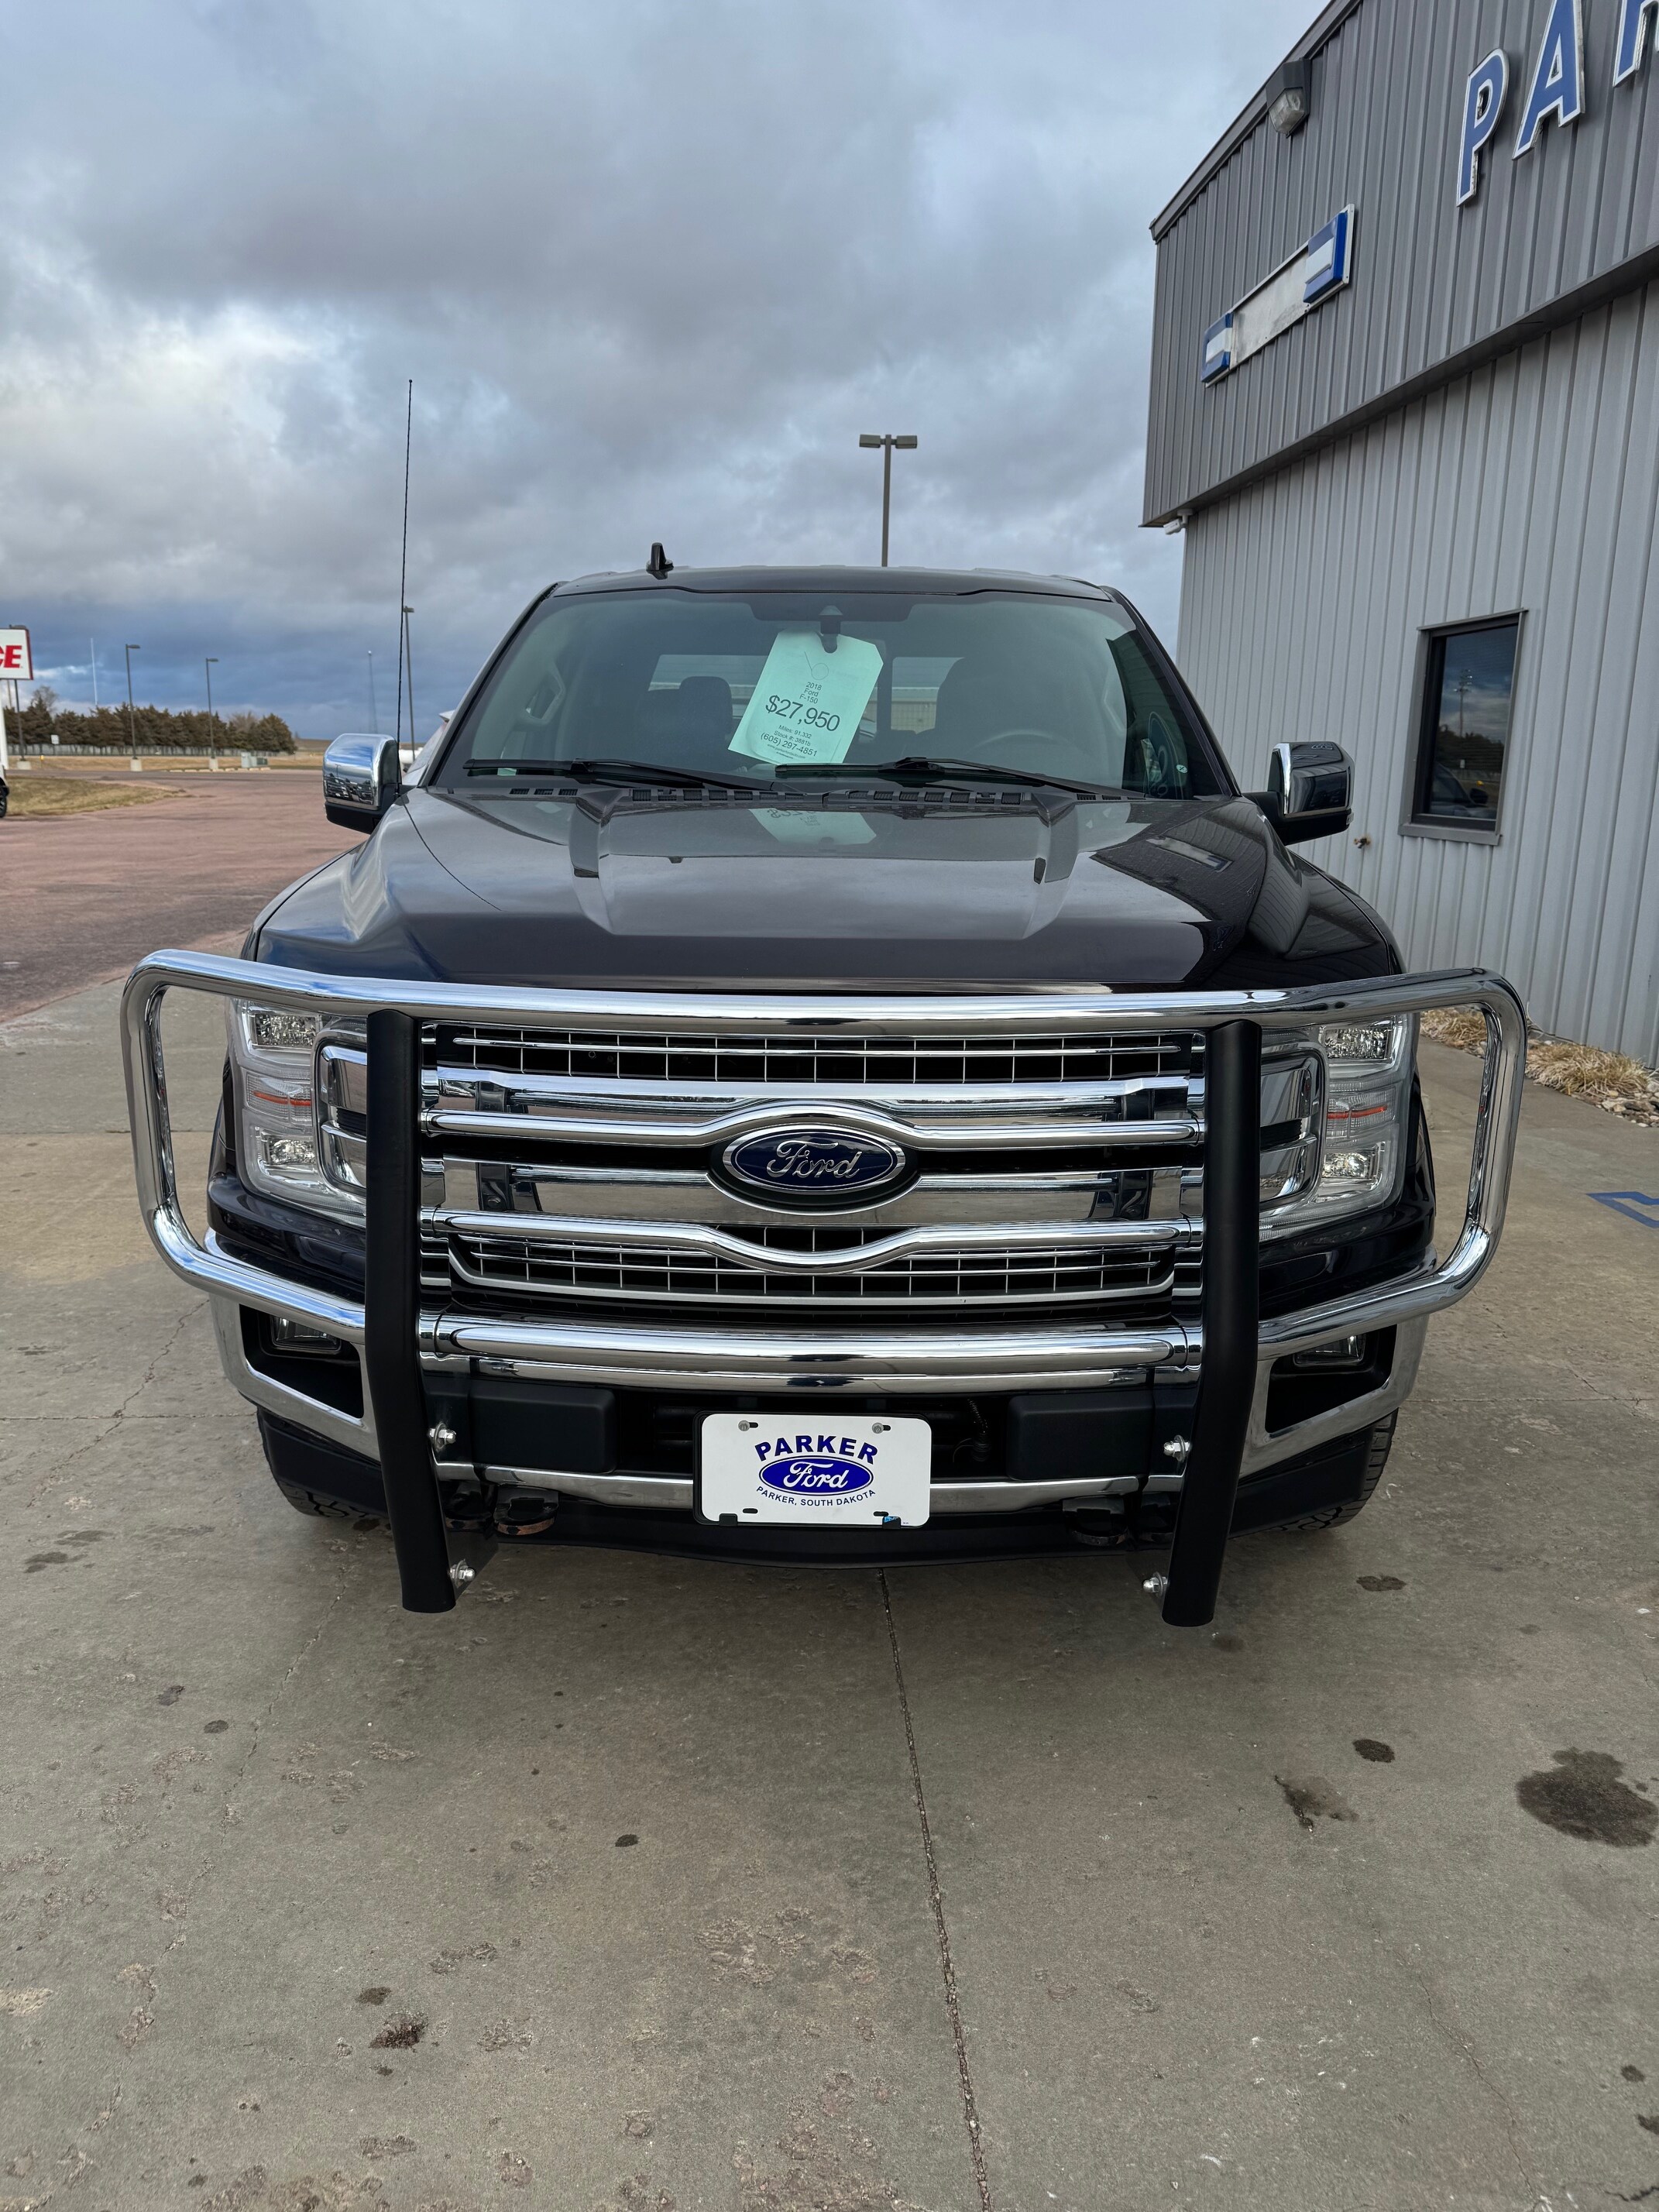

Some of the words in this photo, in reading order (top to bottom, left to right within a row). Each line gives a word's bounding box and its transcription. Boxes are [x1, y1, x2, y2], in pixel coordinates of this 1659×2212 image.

[0, 644, 22, 668] E
[804, 688, 819, 697] Ford
[805, 682, 822, 691] 2018
[799, 694, 819, 704] F-150
[765, 695, 840, 732] $27,950
[761, 732, 781, 747] (605)
[781, 740, 818, 757] 297-4851
[774, 730, 788, 739] Stock
[766, 1140, 863, 1178] Ford
[754, 1434, 878, 1465] PARKER
[782, 1461, 850, 1489] Ford
[756, 1486, 797, 1506] PARKER,
[800, 1498, 834, 1507] SOUTH
[836, 1489, 876, 1506] DAKOTA
